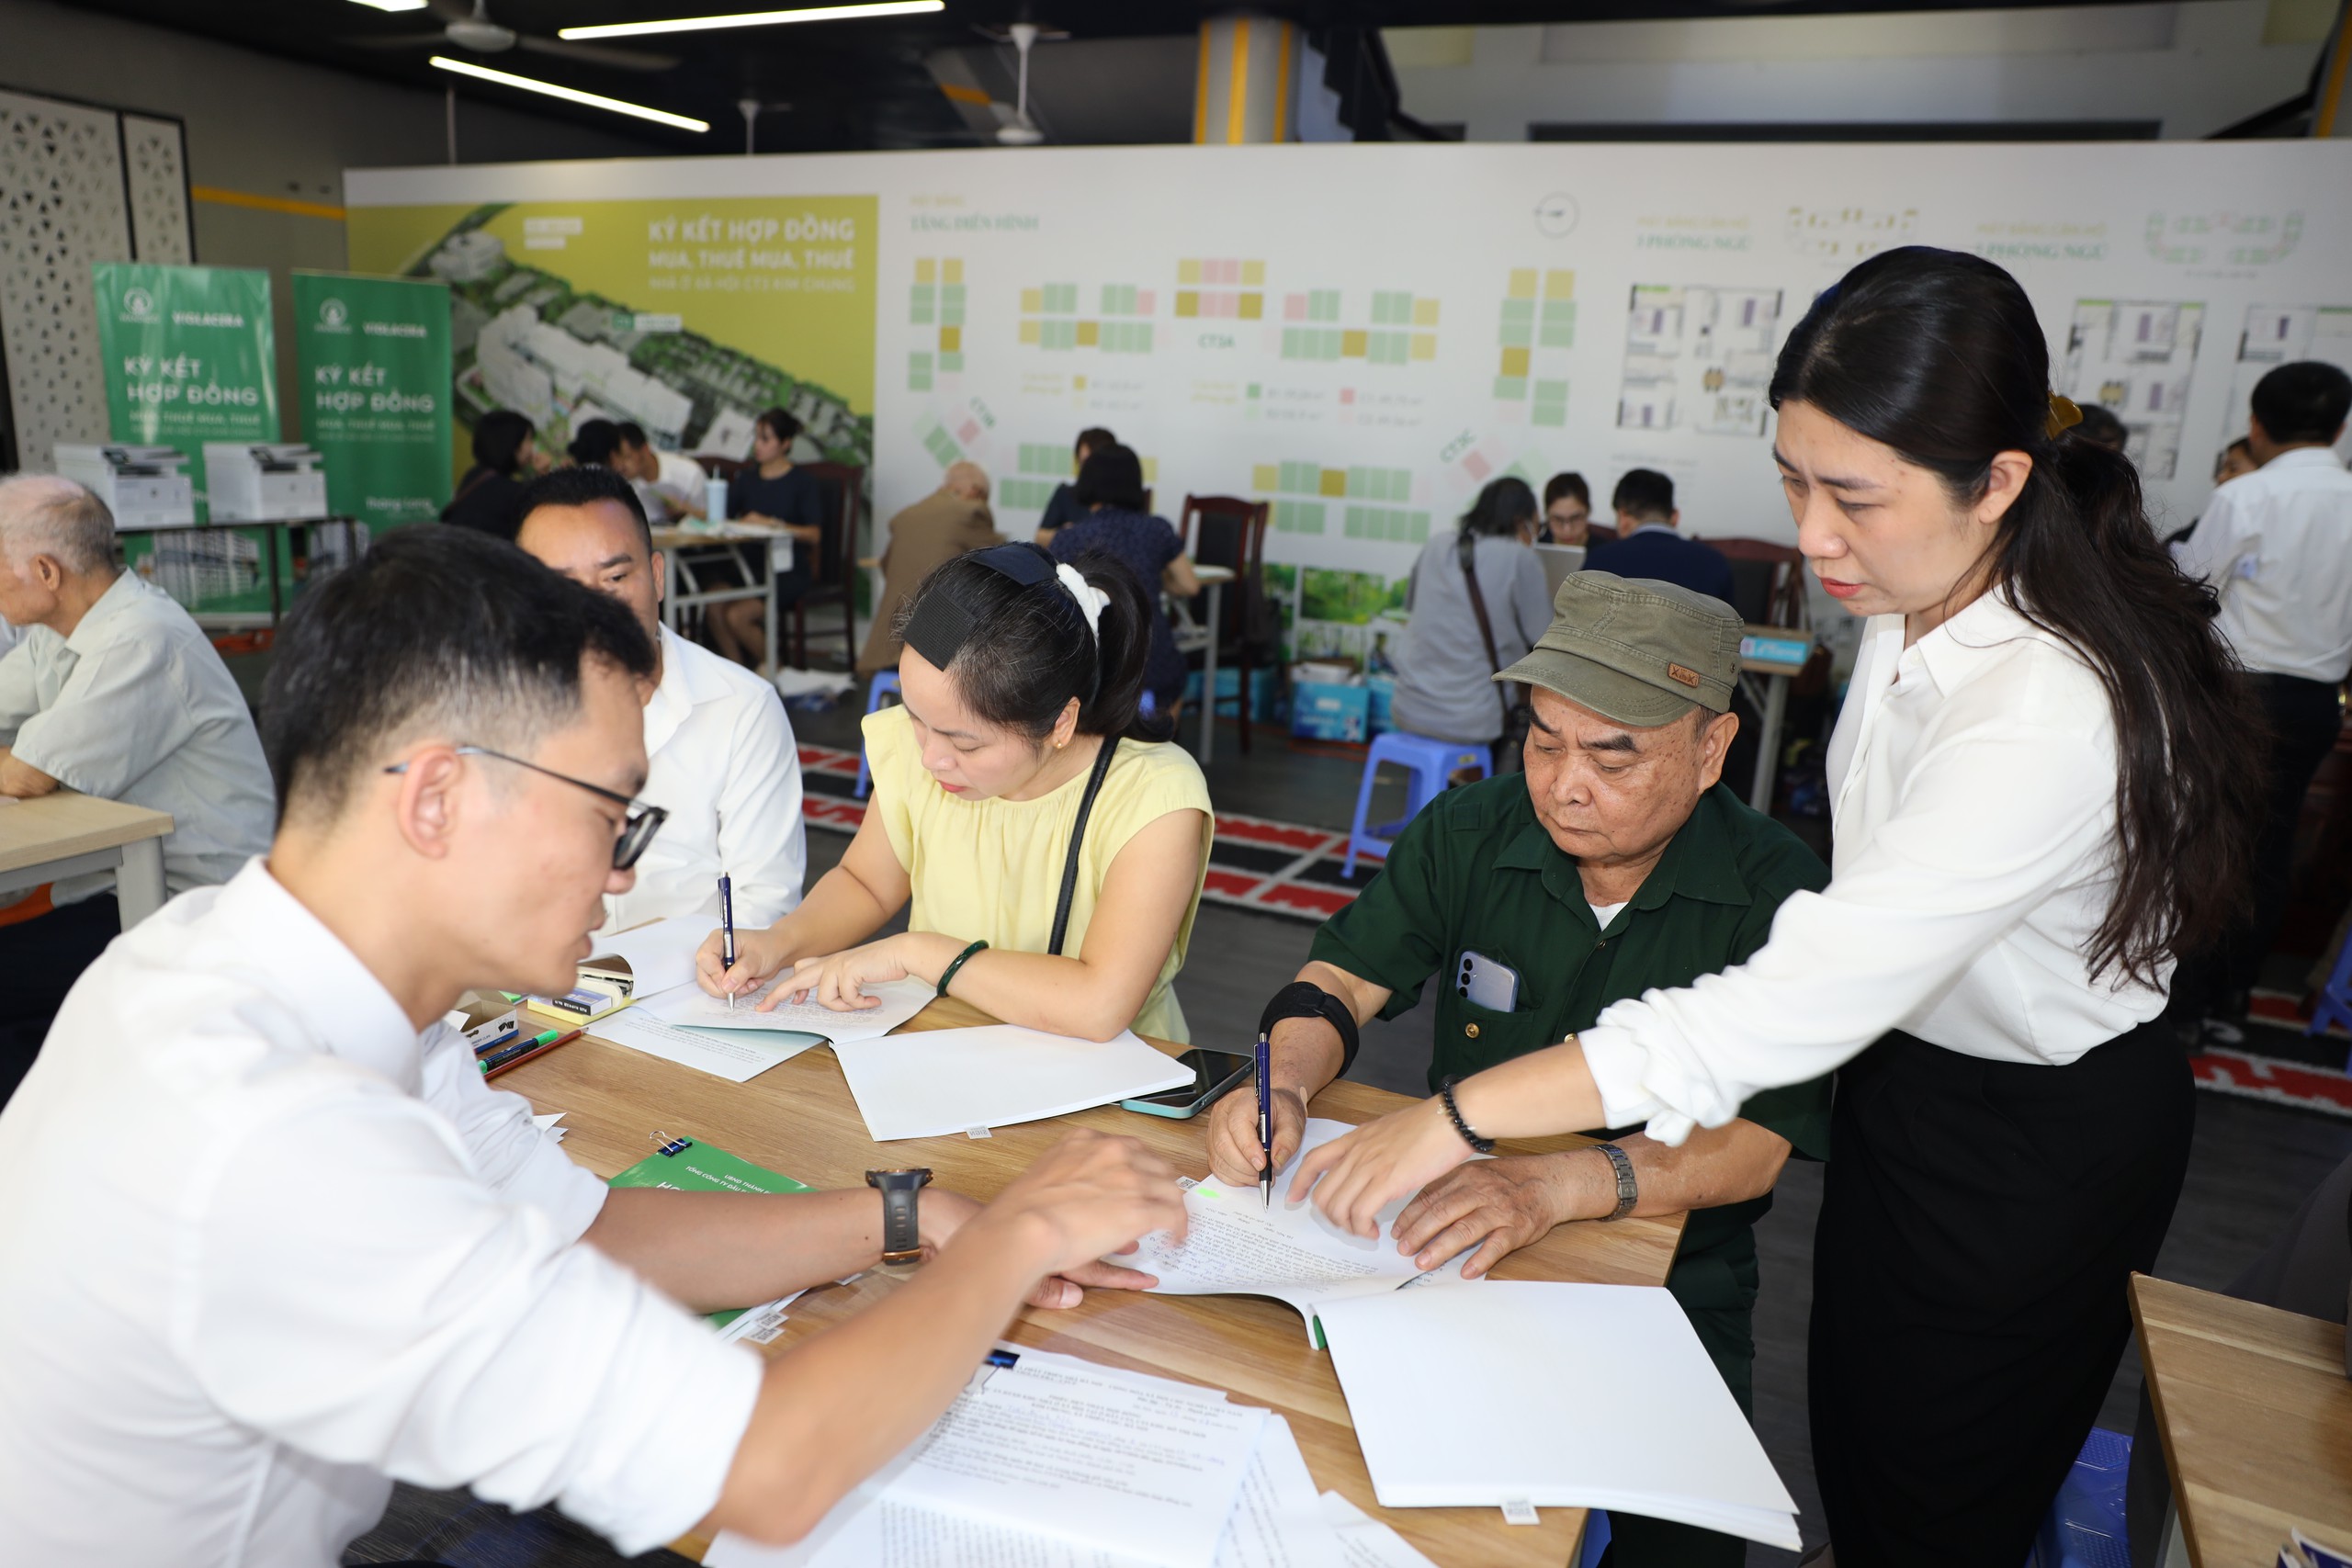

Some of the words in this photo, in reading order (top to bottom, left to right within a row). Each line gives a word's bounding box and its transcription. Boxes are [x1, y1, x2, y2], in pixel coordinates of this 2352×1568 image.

[648, 214, 678, 243] KÝ
[682, 212, 723, 243] KẾT
[728, 216, 780, 246] HỢP
[784, 211, 855, 243] ĐỒNG
[160, 351, 202, 378] KẾT
[315, 363, 343, 385] KÝ
[348, 360, 387, 387] KẾT
[187, 377, 260, 406] ĐỒNG
[315, 389, 366, 414] HỢP
[370, 386, 435, 413] ĐỒNG
[685, 1166, 703, 1176] TỔNG
[702, 1172, 720, 1183] CÔNG
[724, 1174, 742, 1185] UBND
[742, 1181, 764, 1193] THÀNH
